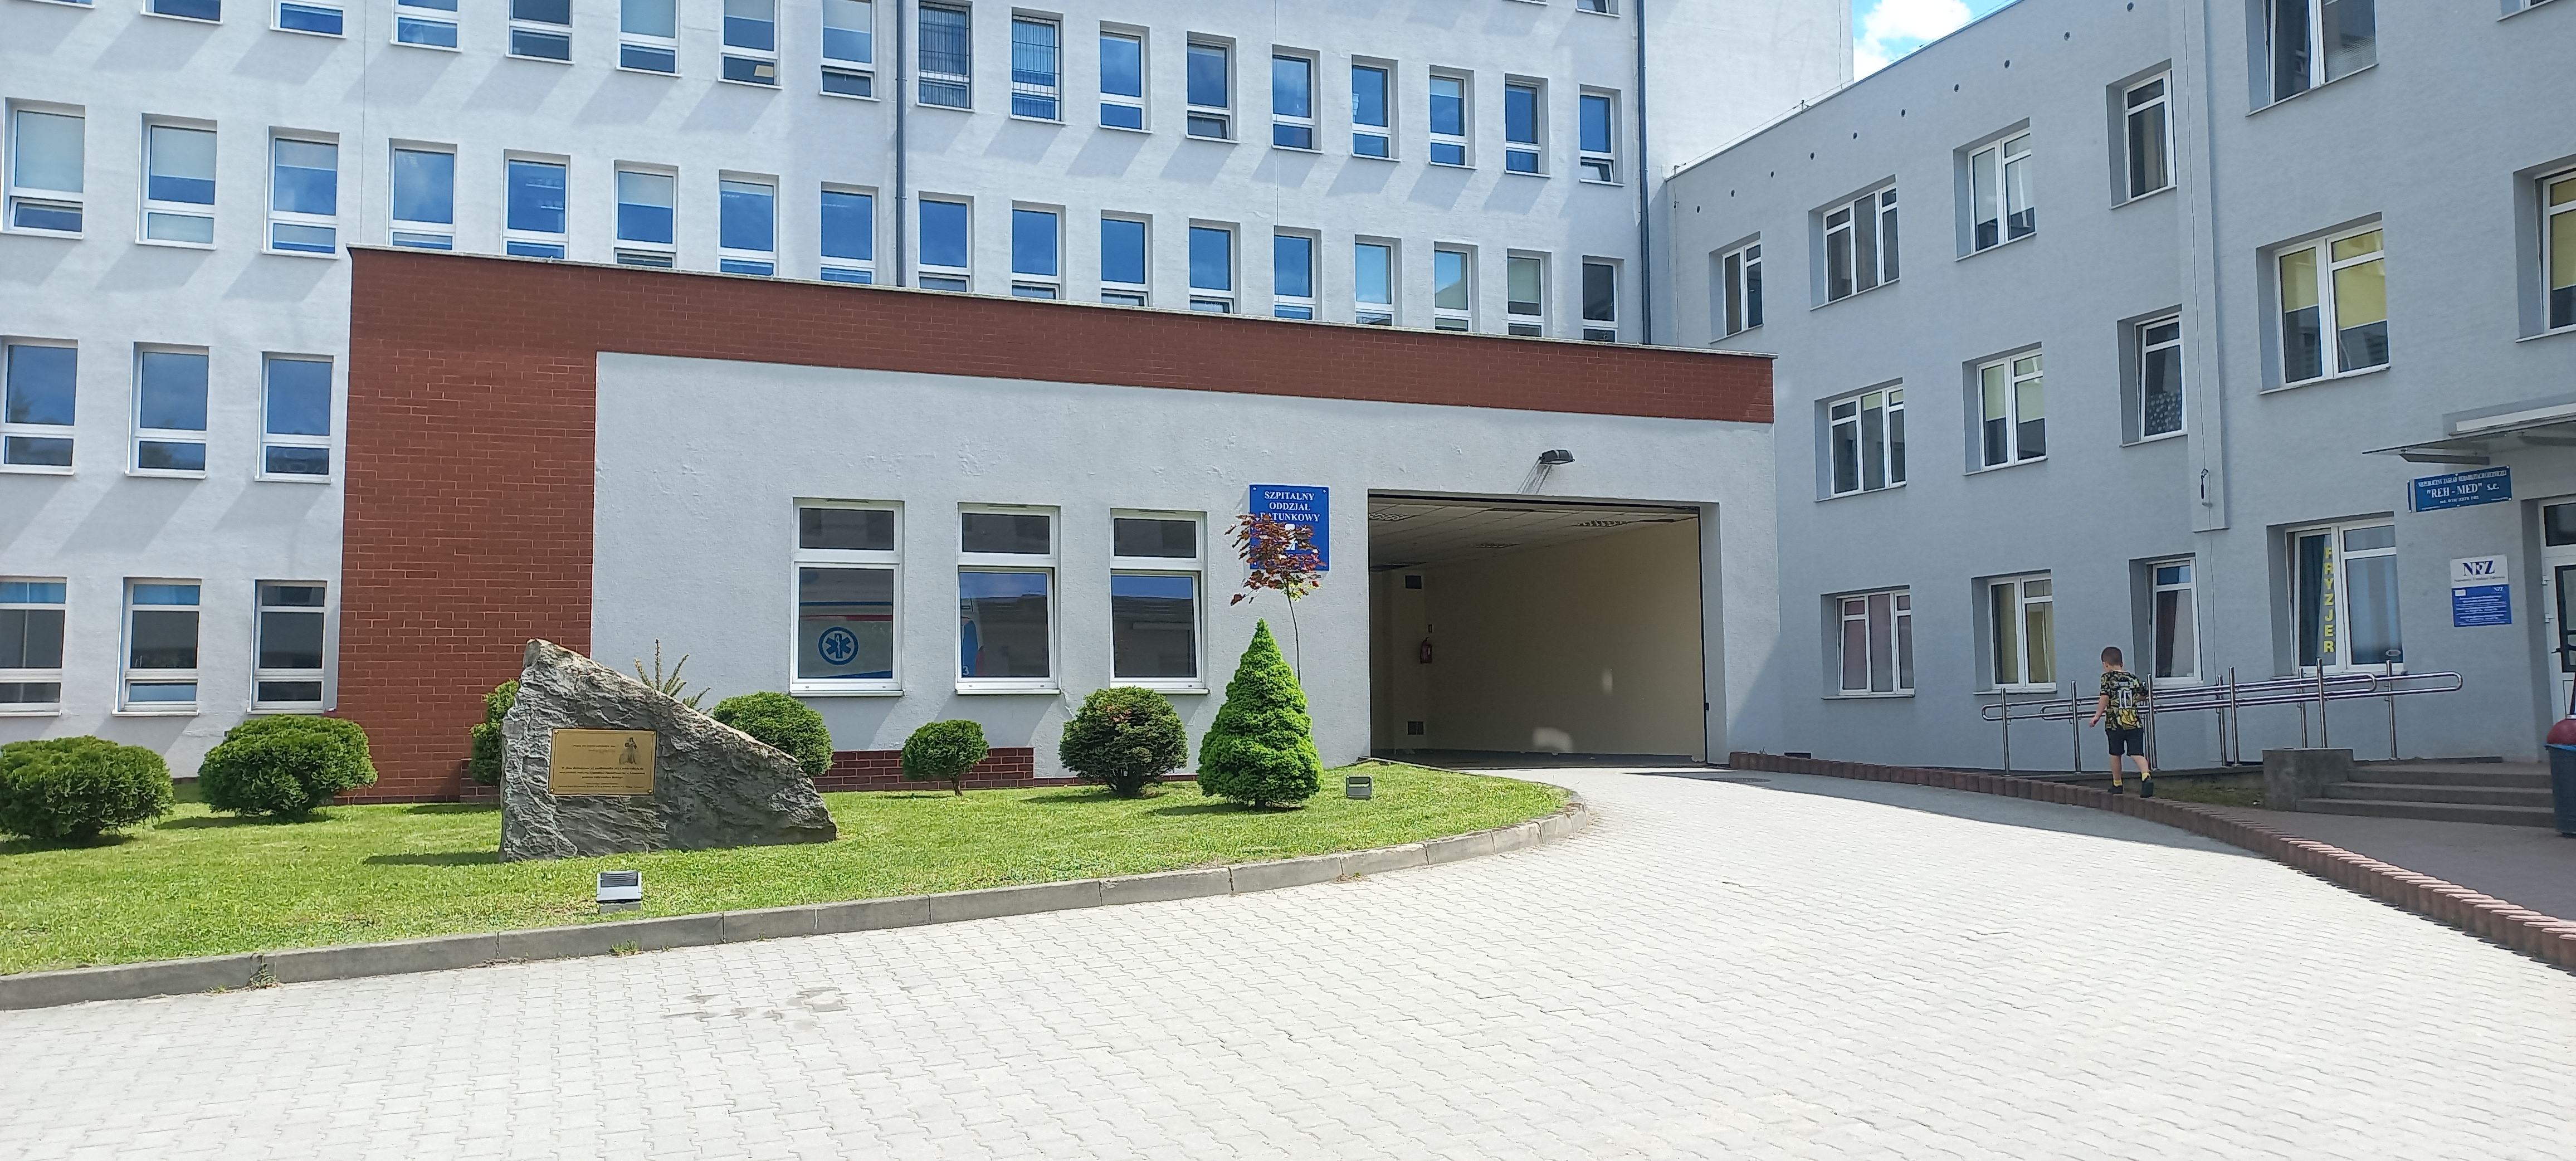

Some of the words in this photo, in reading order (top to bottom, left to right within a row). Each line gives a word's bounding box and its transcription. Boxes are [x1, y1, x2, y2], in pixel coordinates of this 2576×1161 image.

[1265, 491, 1314, 500] SZPITALNY
[1269, 502, 1311, 511] ODDZIAŁ
[2462, 560, 2495, 576] NFZ
[2324, 547, 2334, 652] FRYZJER
[2118, 690, 2132, 709] 10
